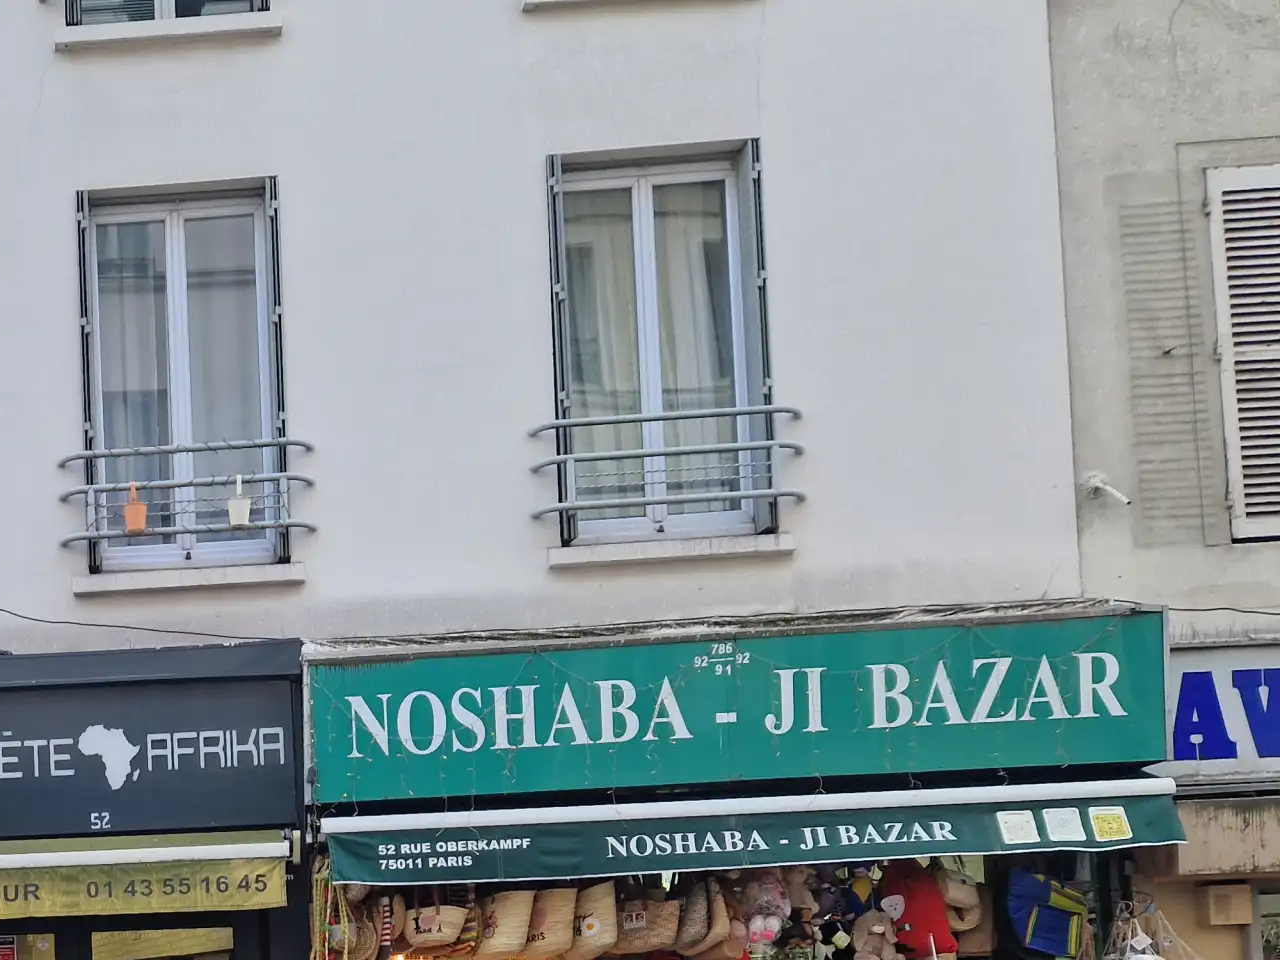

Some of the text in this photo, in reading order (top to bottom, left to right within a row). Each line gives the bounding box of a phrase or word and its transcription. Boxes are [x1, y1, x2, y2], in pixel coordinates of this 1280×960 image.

[711, 642, 733, 654] 786
[694, 652, 750, 667] 92 92
[715, 664, 732, 675] 91
[345, 675, 694, 758] NOSHABA
[764, 667, 828, 735] JI
[866, 652, 1128, 730] BAZAR
[147, 727, 285, 771] AFRIKA
[90, 812, 111, 829] 52
[378, 838, 531, 855] 52 RUE OBERKAMPF
[605, 829, 770, 858] NOSHABA
[800, 826, 829, 850] JI
[837, 821, 958, 846] BAZAR
[379, 855, 472, 870] 75011 PARIS
[86, 881, 114, 899] 01
[124, 880, 153, 897] 43
[162, 878, 191, 896] 55
[200, 875, 229, 894] 16
[237, 873, 268, 892] 45
[526, 932, 547, 944] ARIS
